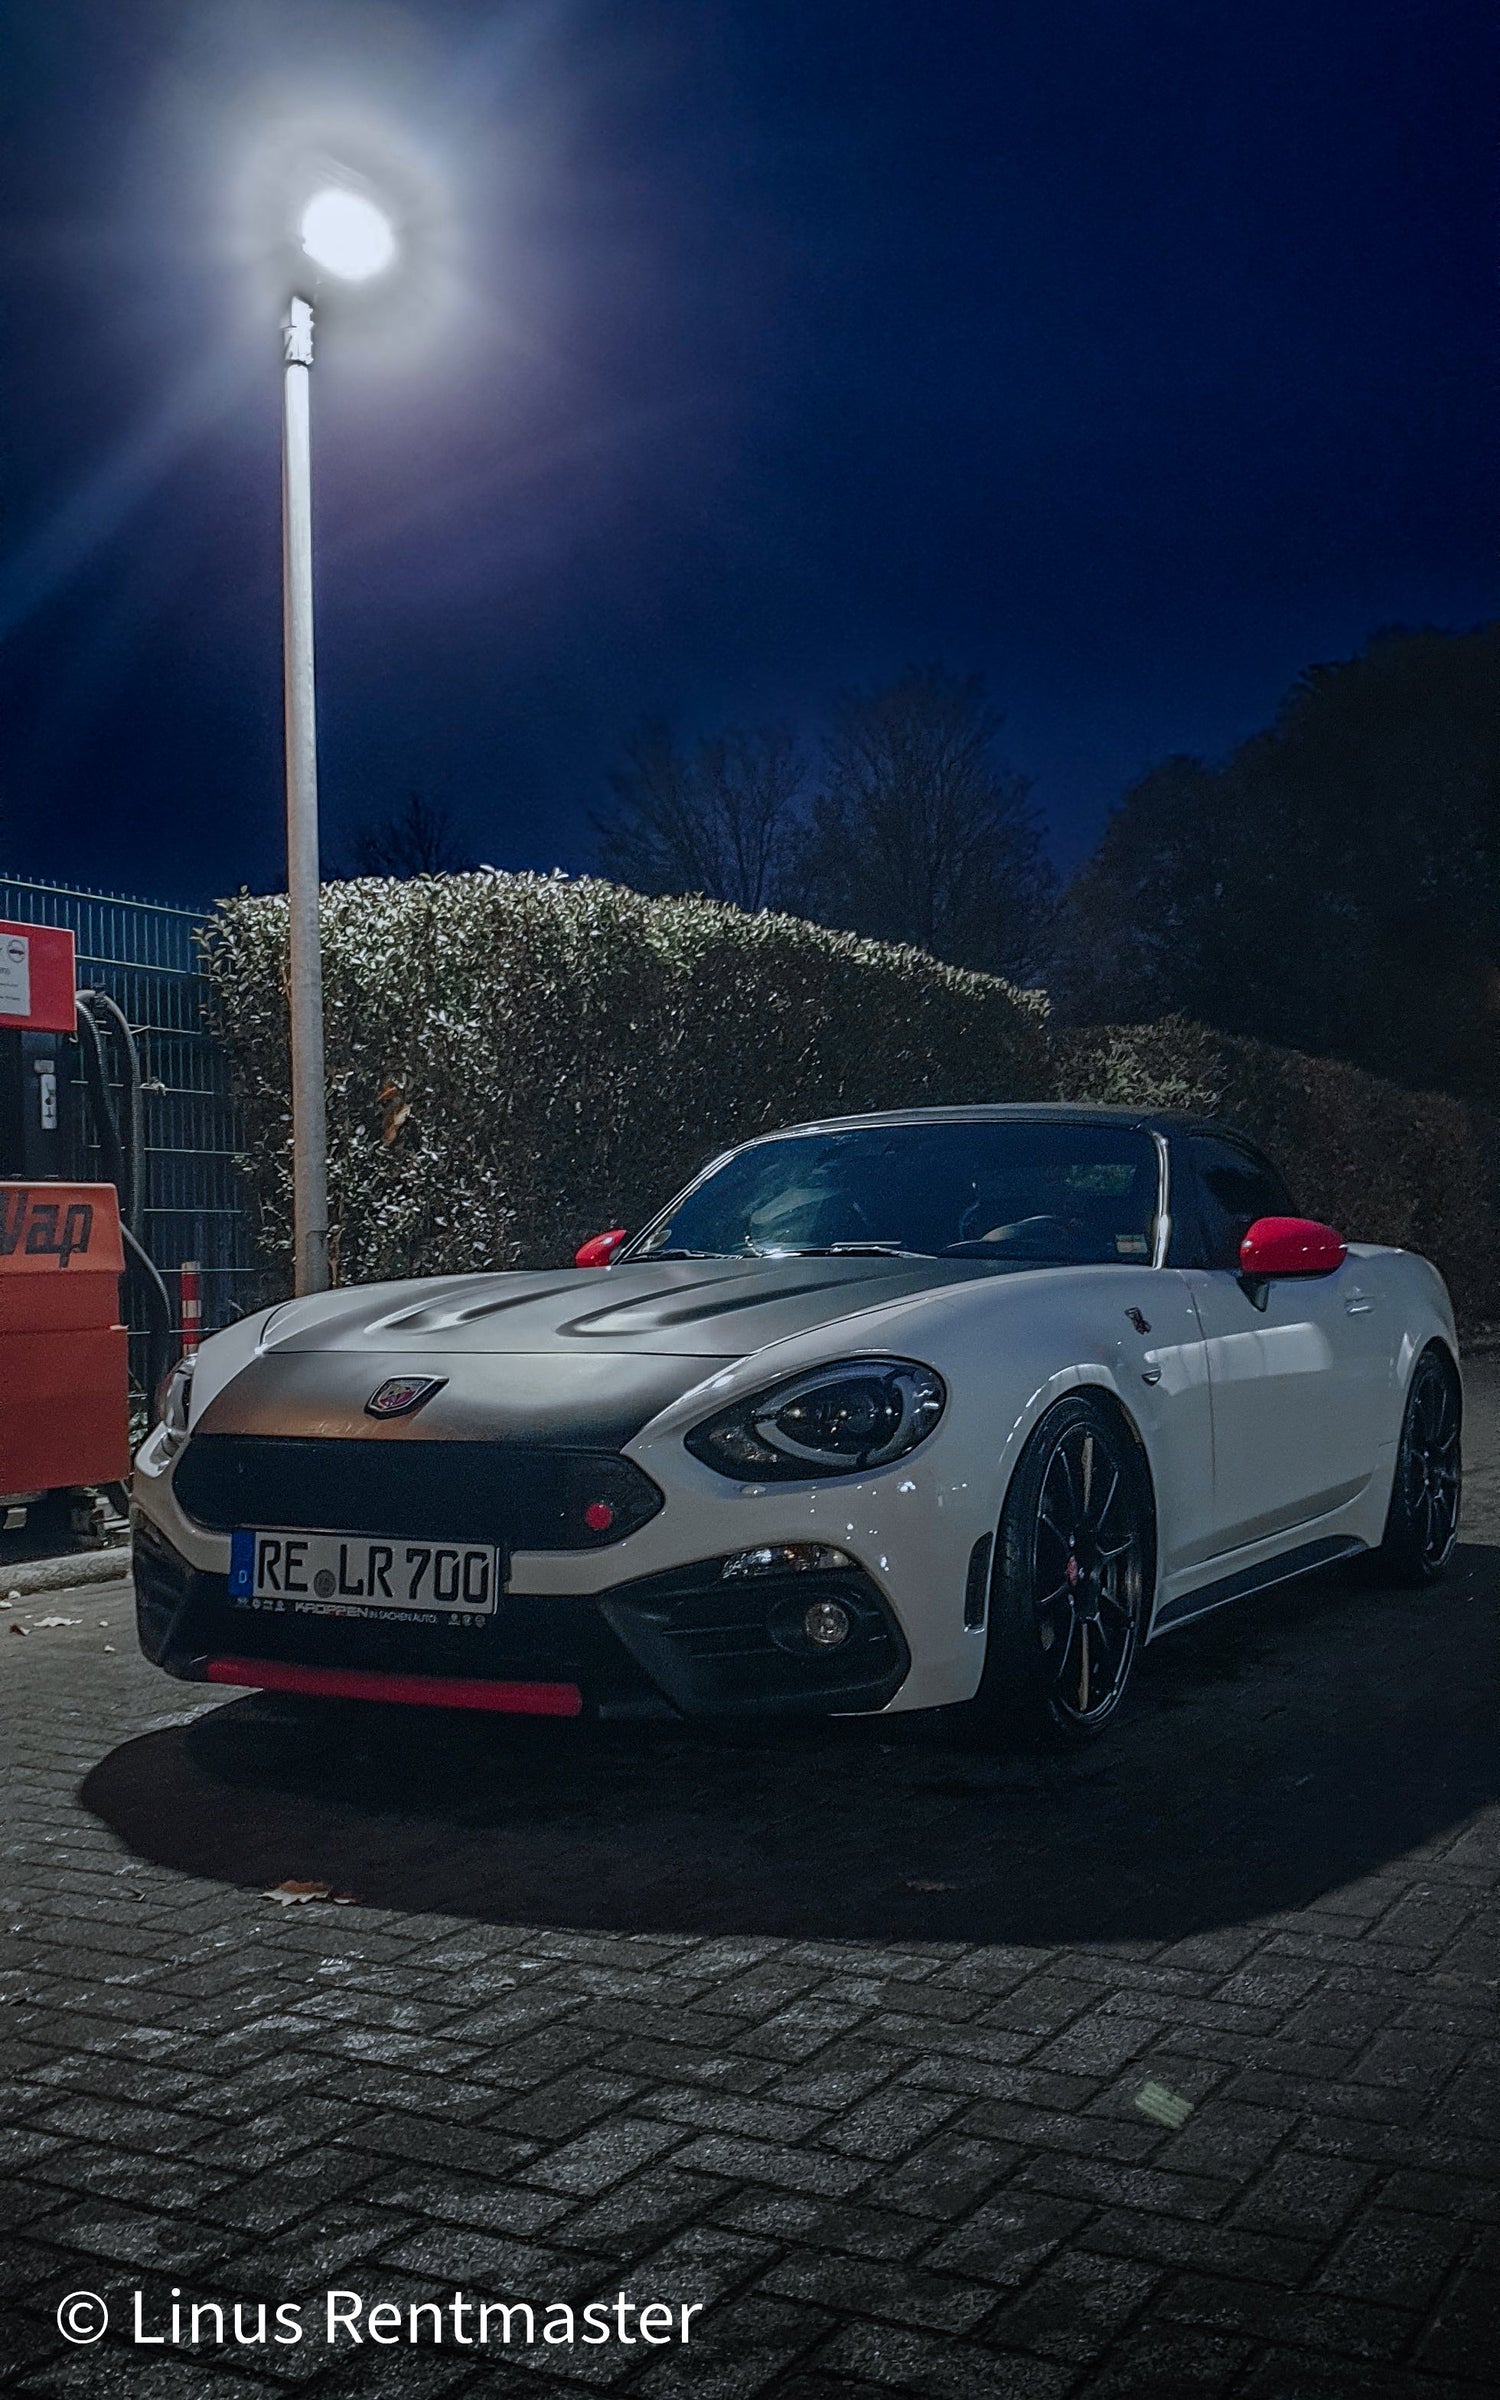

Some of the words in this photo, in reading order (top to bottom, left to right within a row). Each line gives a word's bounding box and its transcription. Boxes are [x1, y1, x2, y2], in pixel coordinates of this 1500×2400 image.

[238, 1569, 248, 1584] D
[257, 1540, 309, 1592] RE
[339, 1544, 393, 1598] LR
[406, 1548, 490, 1604] 700
